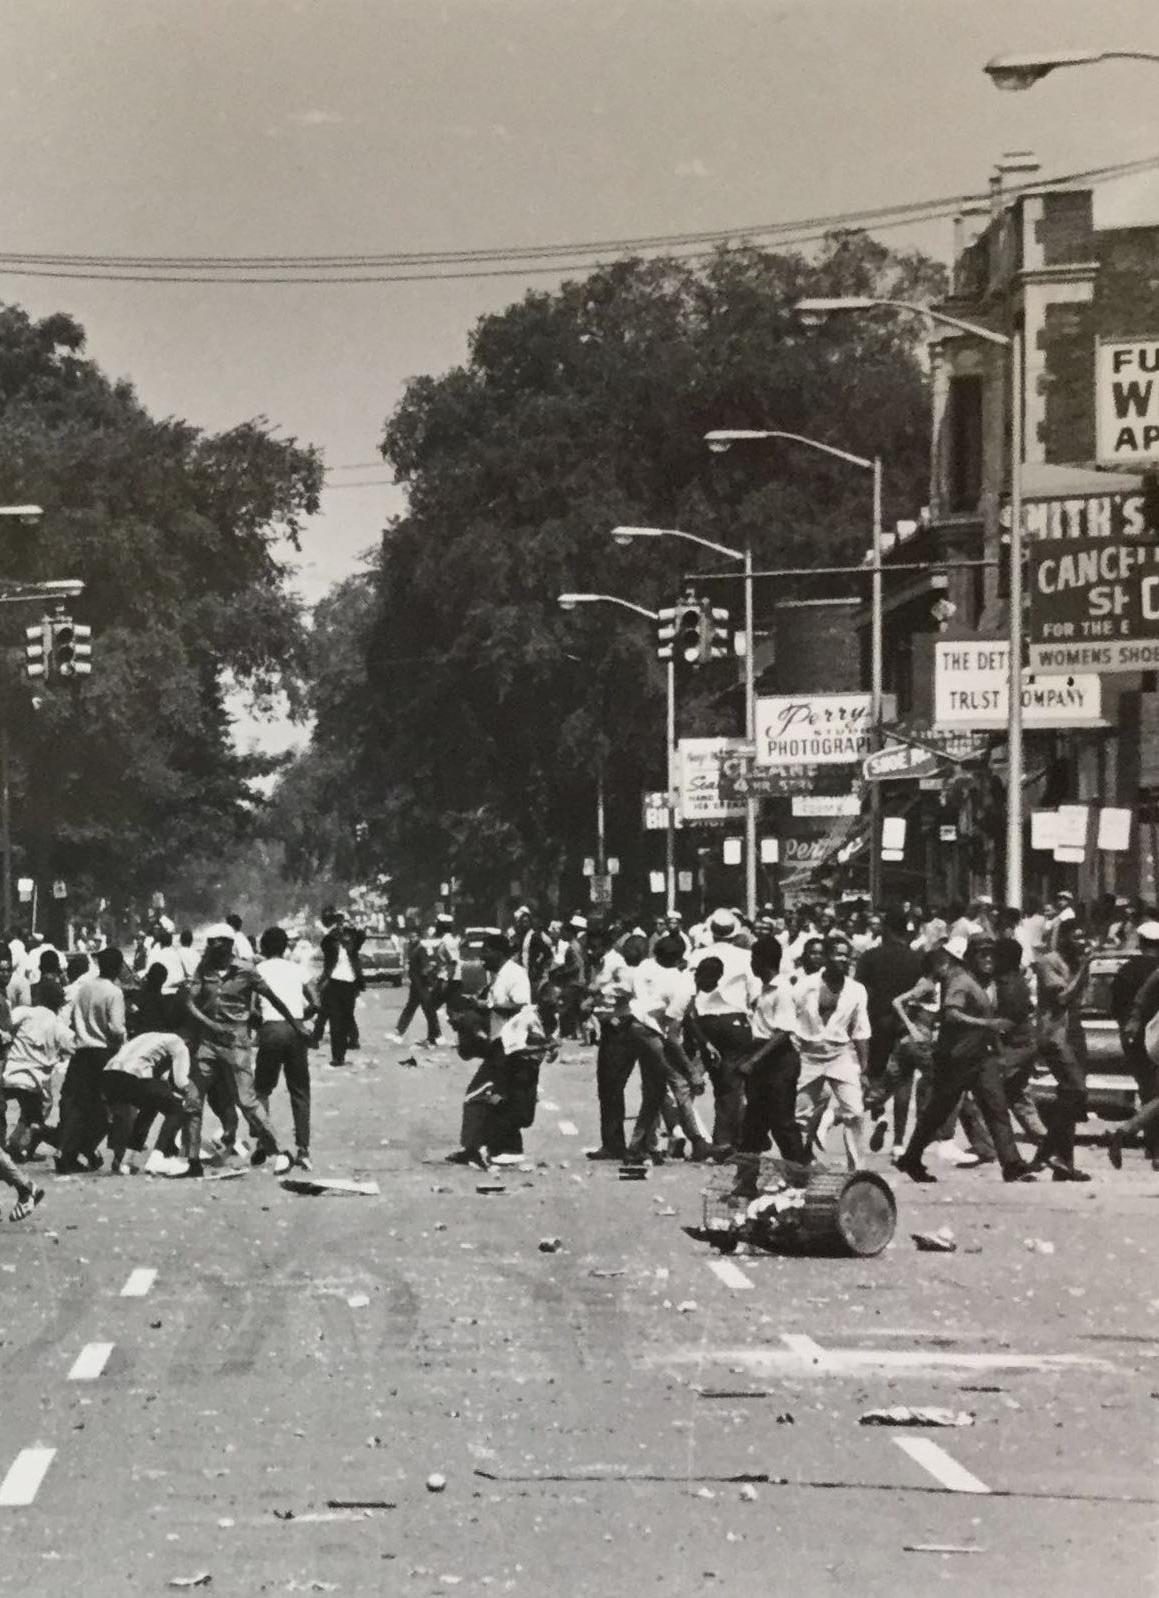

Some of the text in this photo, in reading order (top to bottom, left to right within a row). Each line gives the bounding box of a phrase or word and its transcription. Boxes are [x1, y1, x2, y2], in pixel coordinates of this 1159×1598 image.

[1043, 622, 1075, 637] FOR
[1080, 620, 1113, 636] THE
[943, 652, 971, 671] THE
[1039, 647, 1112, 666] WOMENS
[1021, 688, 1085, 708] OMPANY
[765, 703, 868, 739] Perry
